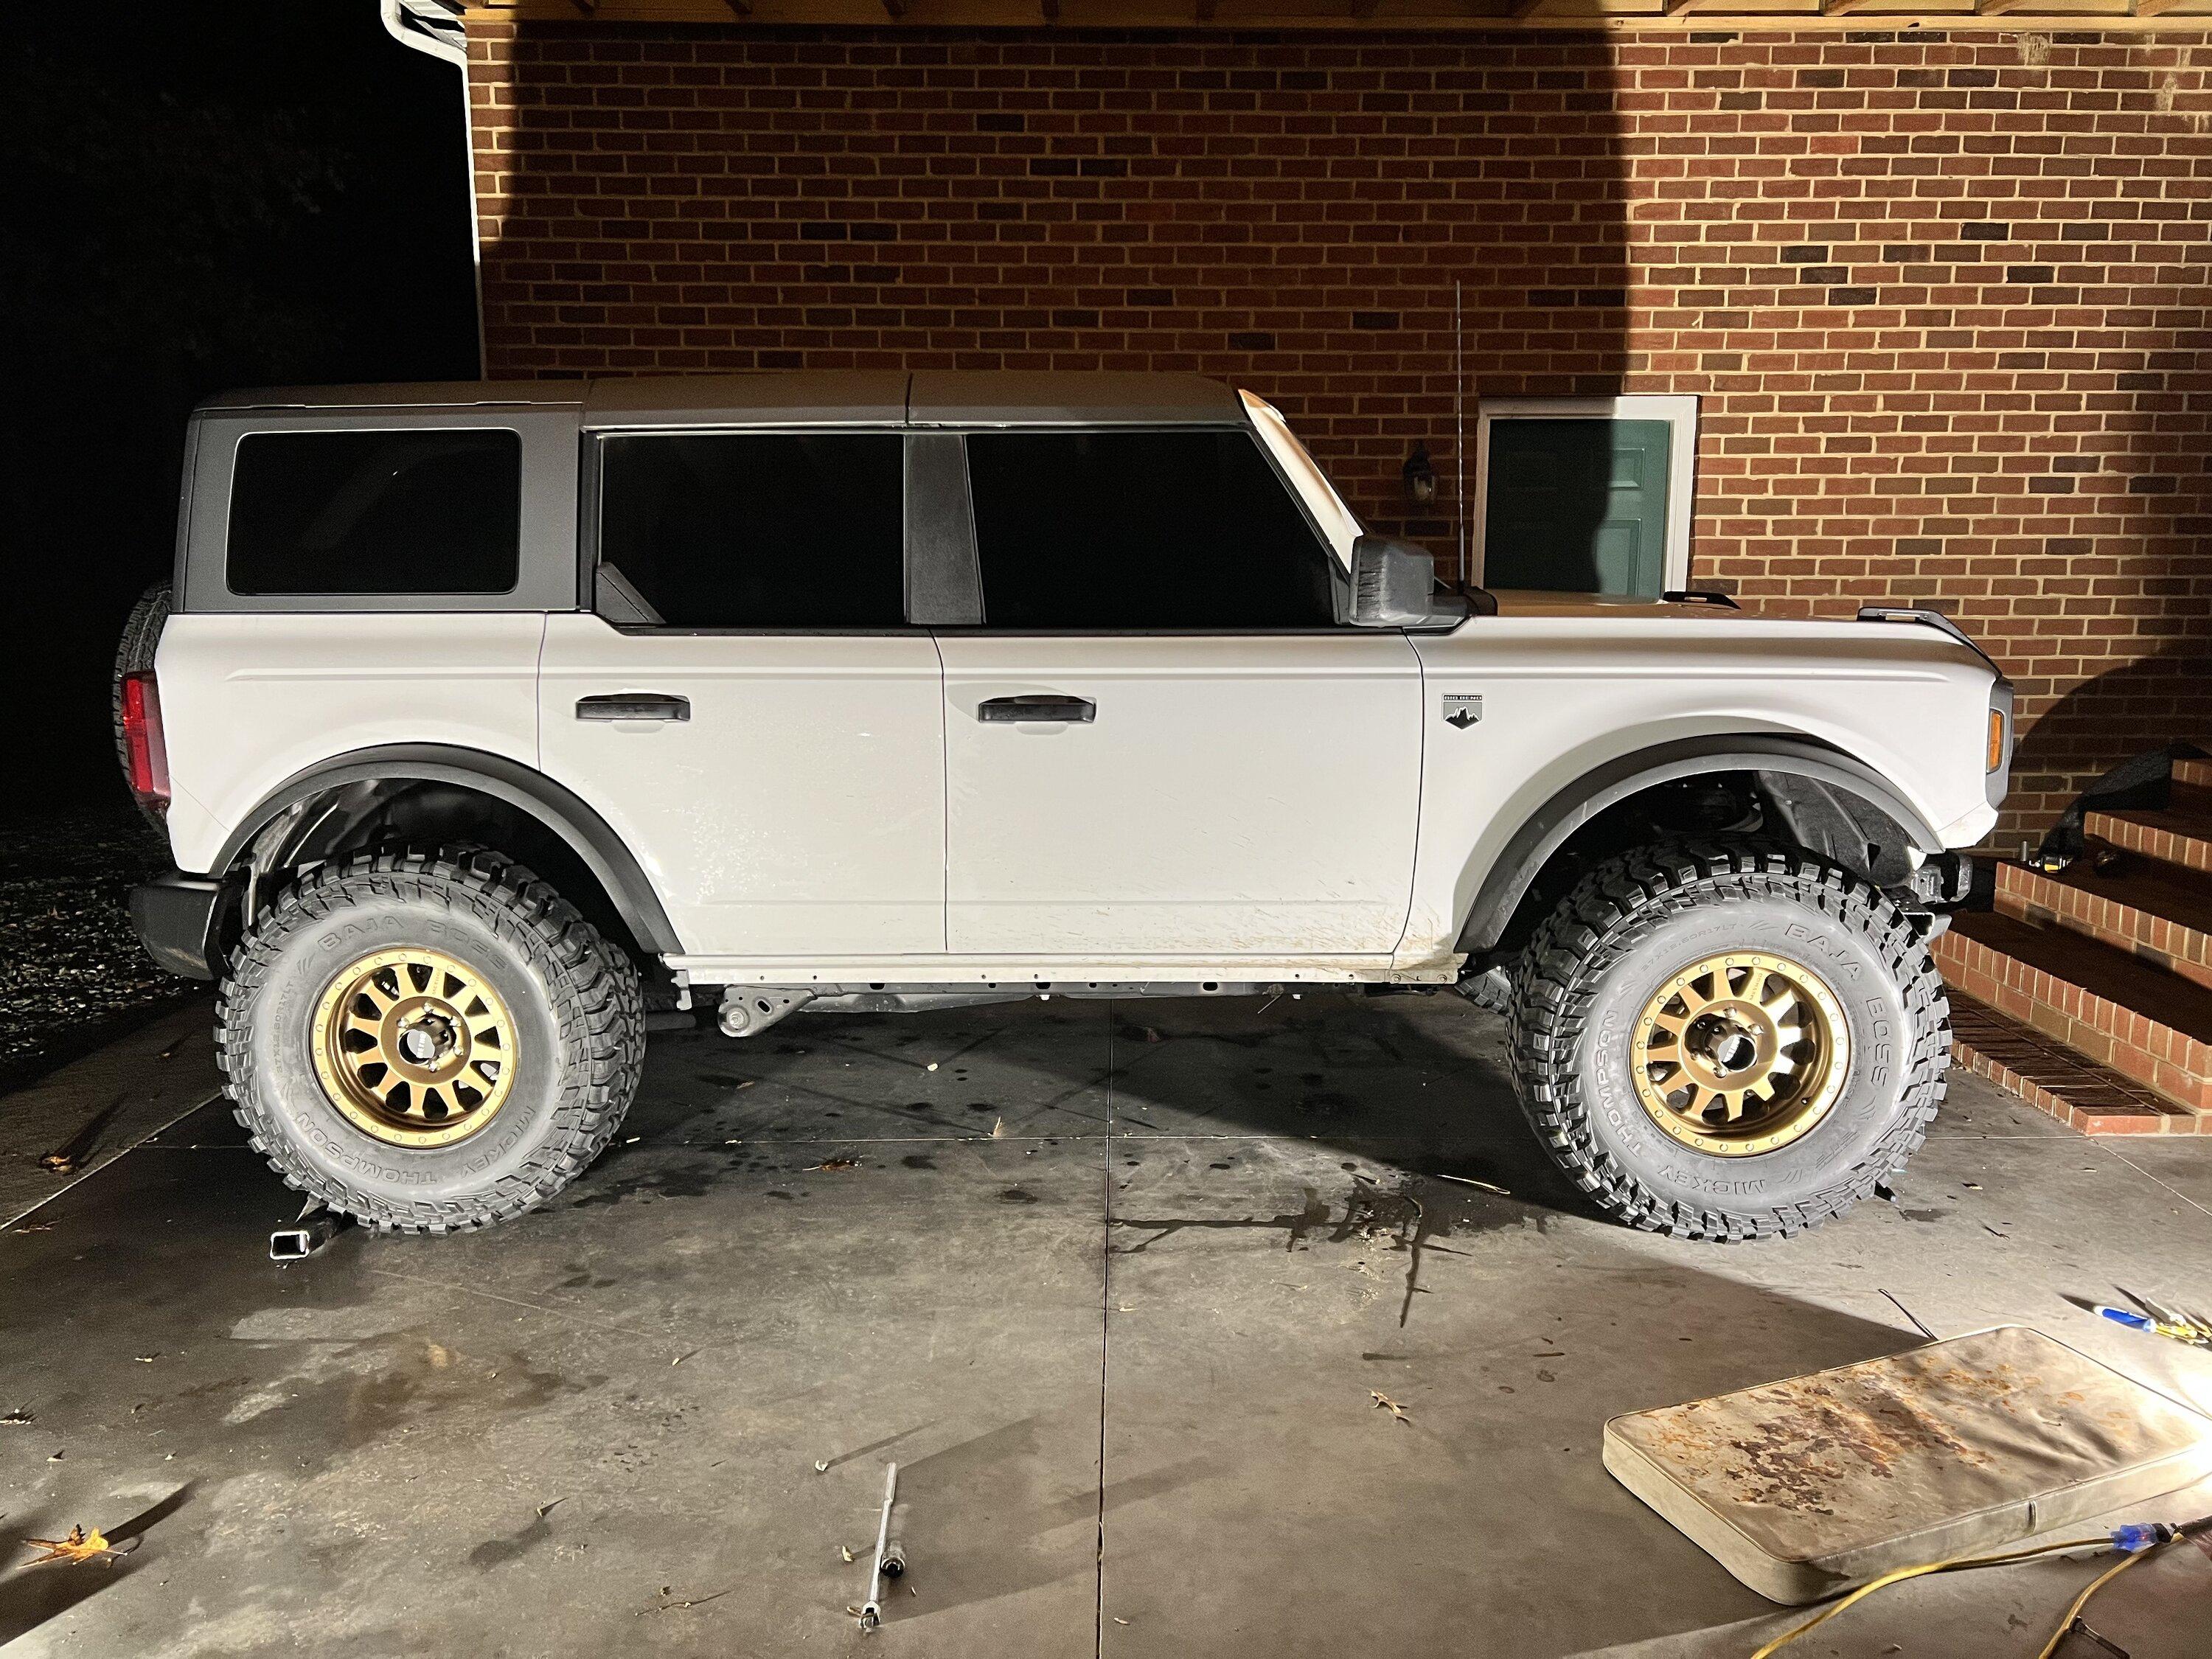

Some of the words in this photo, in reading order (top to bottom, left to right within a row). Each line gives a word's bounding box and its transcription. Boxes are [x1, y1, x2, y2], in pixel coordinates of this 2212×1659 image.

[318, 916, 405, 951] BAJA
[426, 919, 507, 970] BOSS
[1785, 923, 1863, 981] BAJA
[1865, 997, 1893, 1087] BOSS
[1596, 1009, 1641, 1158] THOMPSON
[295, 1112, 438, 1186] THOMPSON
[459, 1105, 536, 1179] MICKEY
[1658, 1165, 1767, 1195] MICKEY
